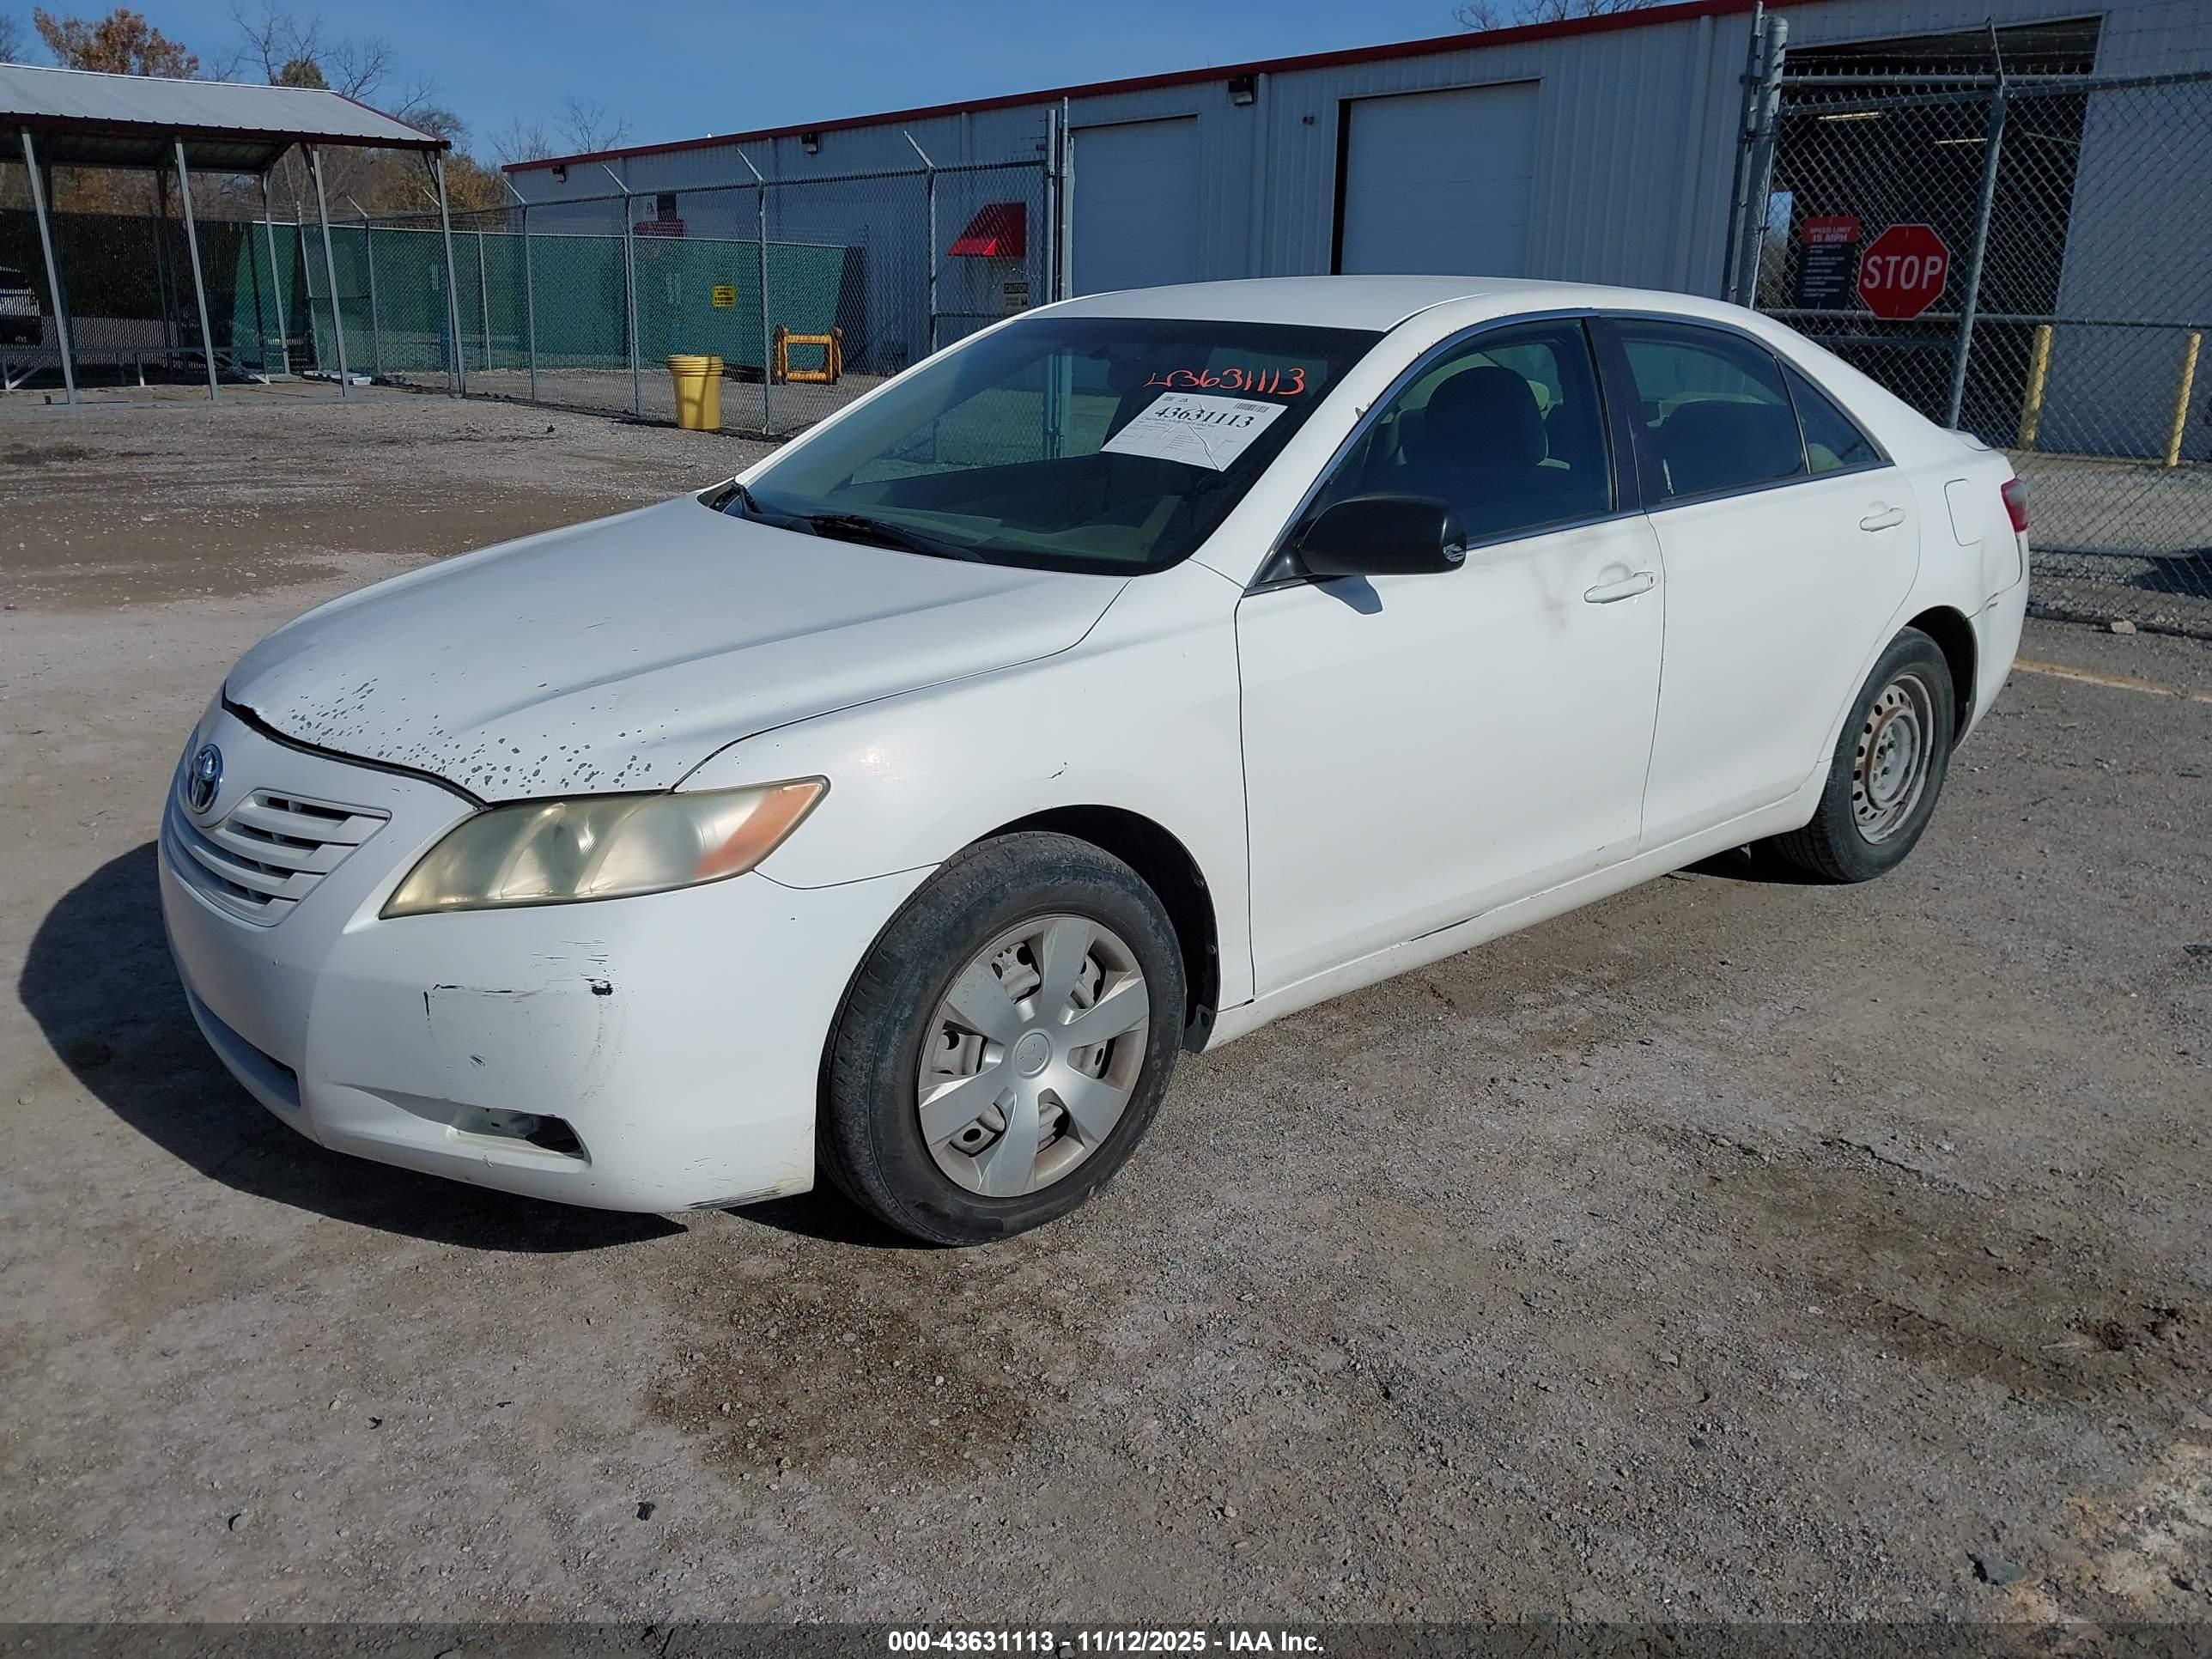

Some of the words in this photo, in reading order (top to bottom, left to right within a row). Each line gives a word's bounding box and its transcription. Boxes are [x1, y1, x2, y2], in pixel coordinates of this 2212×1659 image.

[1826, 234, 1848, 242] MPH
[1863, 255, 1942, 289] STOP
[1005, 284, 1028, 293] CAUTION
[1143, 368, 1306, 396] 43631113
[1154, 405, 1255, 428] 43631113
